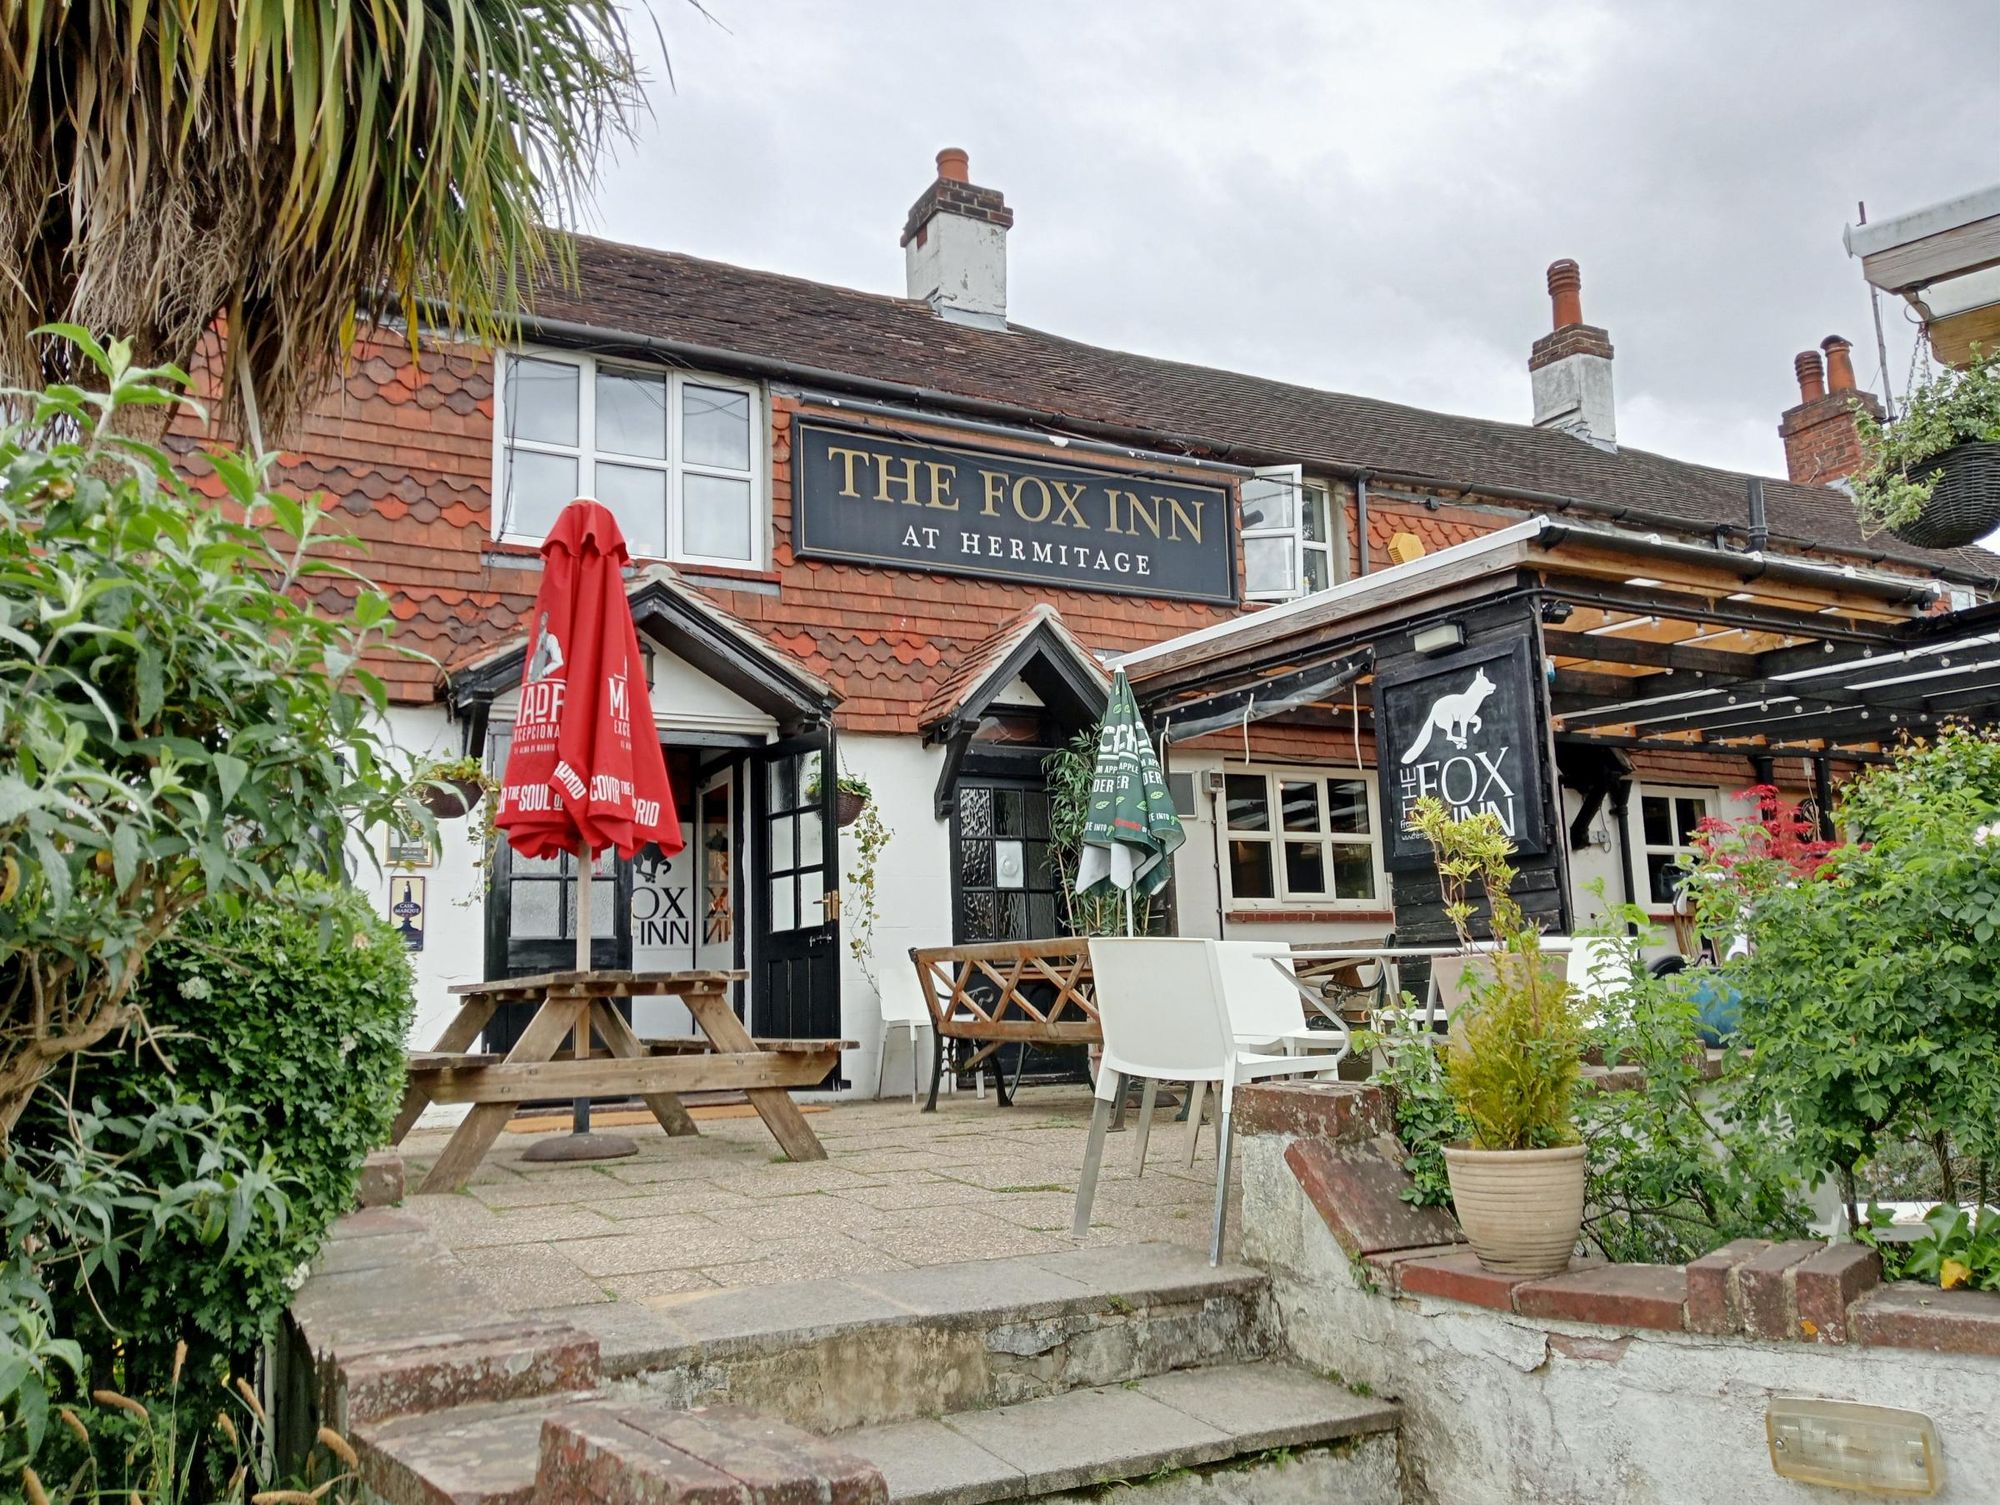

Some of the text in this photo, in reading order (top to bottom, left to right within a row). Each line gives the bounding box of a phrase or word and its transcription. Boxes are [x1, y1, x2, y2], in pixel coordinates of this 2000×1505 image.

[828, 446, 1205, 545] THE FOX INN
[902, 525, 1151, 576] AT HERMITAGE
[1119, 762, 1140, 775] APPLE
[1142, 770, 1164, 786] DER
[1416, 746, 1515, 806] FOX
[508, 785, 521, 801] THE
[518, 783, 551, 812] SOUL
[620, 780, 632, 796] THE
[1093, 778, 1115, 793] DER
[1400, 766, 1418, 819] THE
[640, 920, 690, 946] INN
